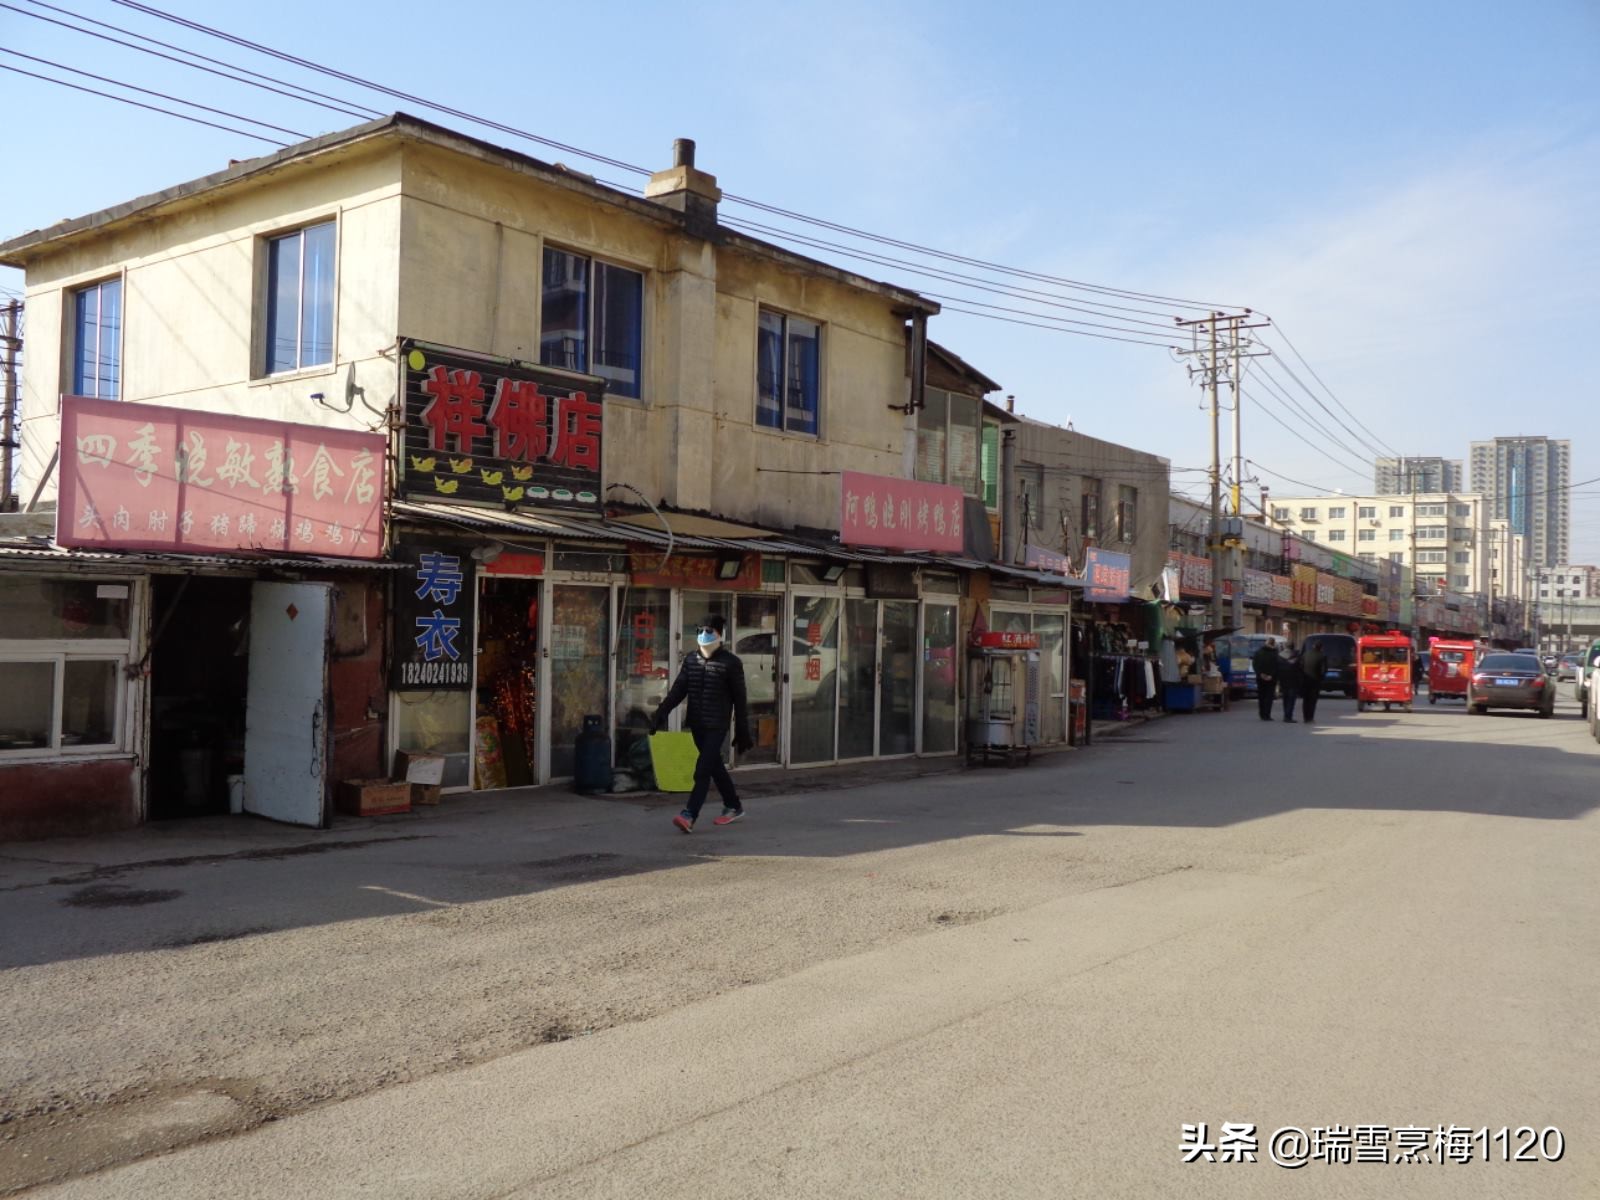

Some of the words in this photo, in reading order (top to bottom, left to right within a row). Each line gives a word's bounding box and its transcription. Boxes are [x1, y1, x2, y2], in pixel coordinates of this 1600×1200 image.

[420, 364, 602, 473] 祥佛店
[414, 551, 464, 662] 寿衣
[401, 661, 469, 685] 18240241939
